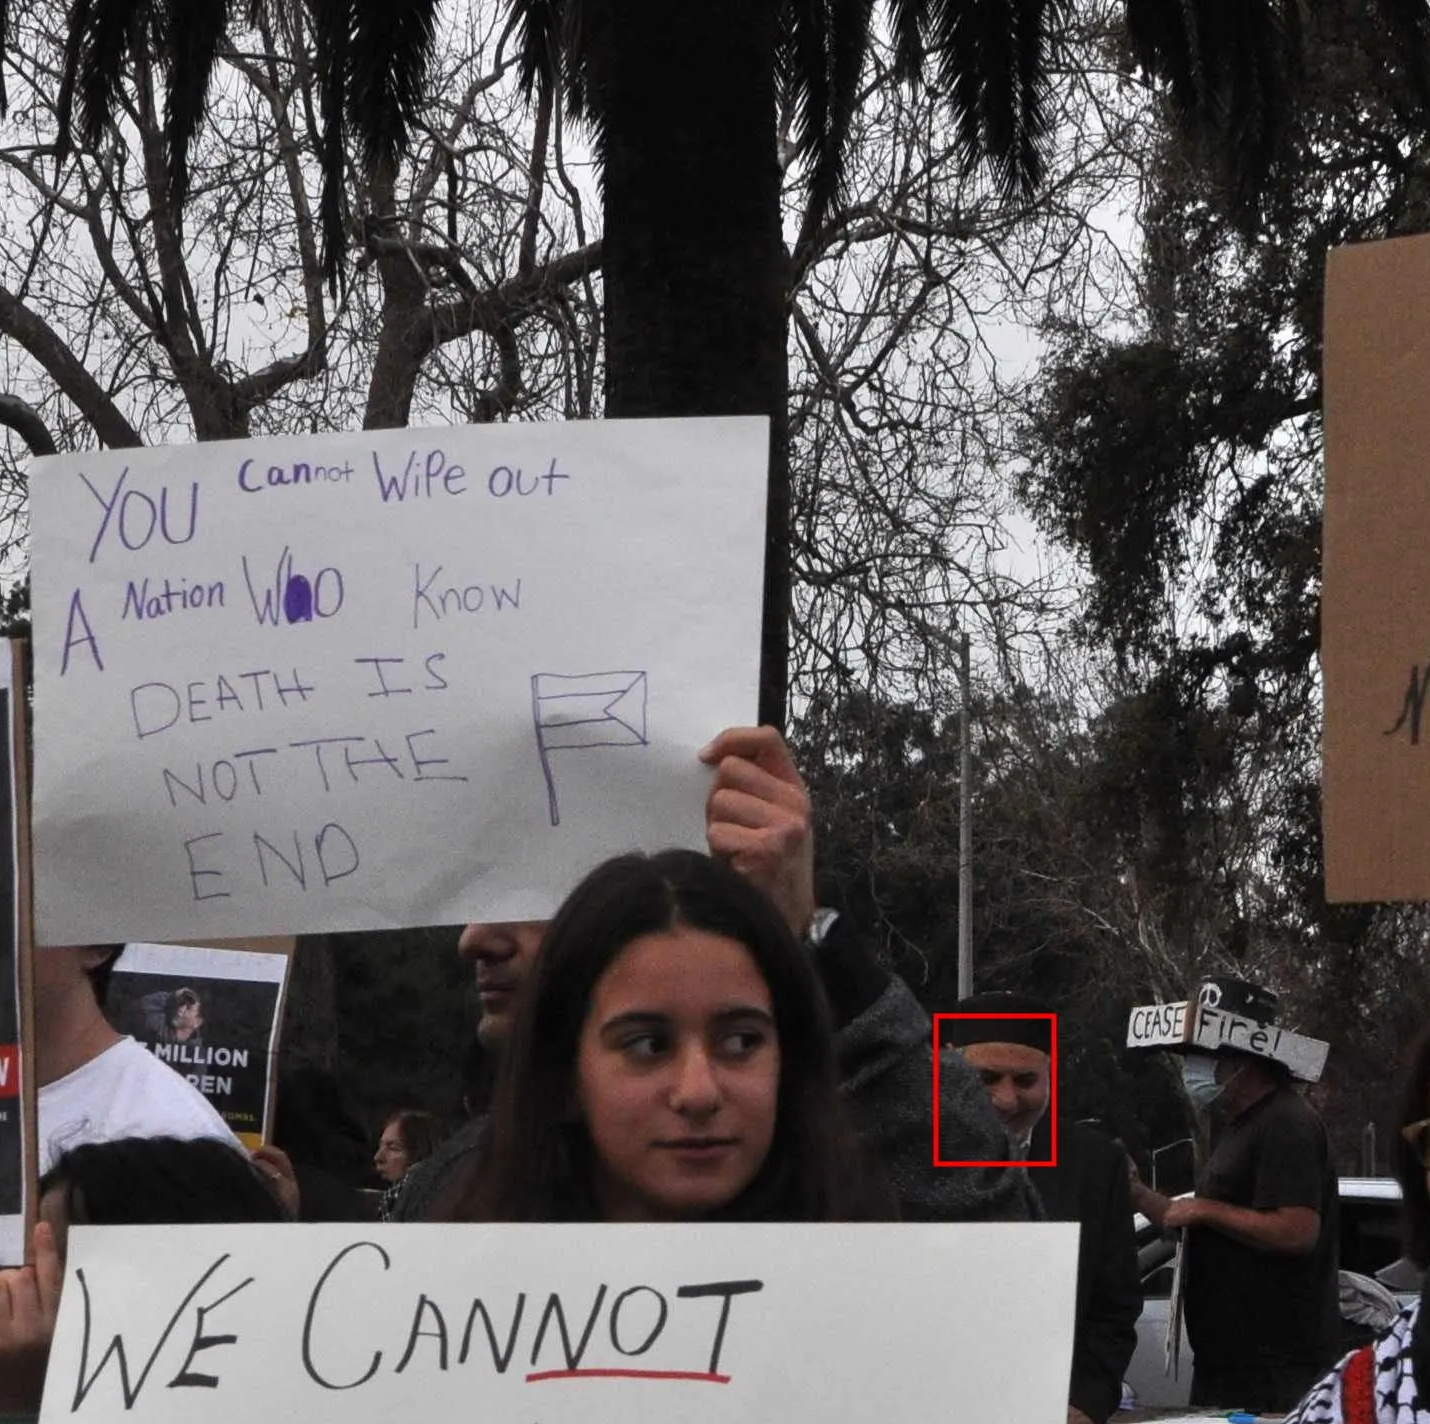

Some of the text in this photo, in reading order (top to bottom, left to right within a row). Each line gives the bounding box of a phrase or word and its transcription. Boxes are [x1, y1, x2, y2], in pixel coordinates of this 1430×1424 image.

[488, 456, 571, 498] out
[59, 589, 105, 676] A
[121, 579, 227, 624] Nation
[129, 652, 450, 741] DEATH IS
[162, 728, 469, 809] NOT THE
[183, 822, 360, 900] END
[154, 1042, 249, 1069] MILLION
[1132, 1005, 1187, 1040] CEASE
[70, 1250, 256, 1415] WE
